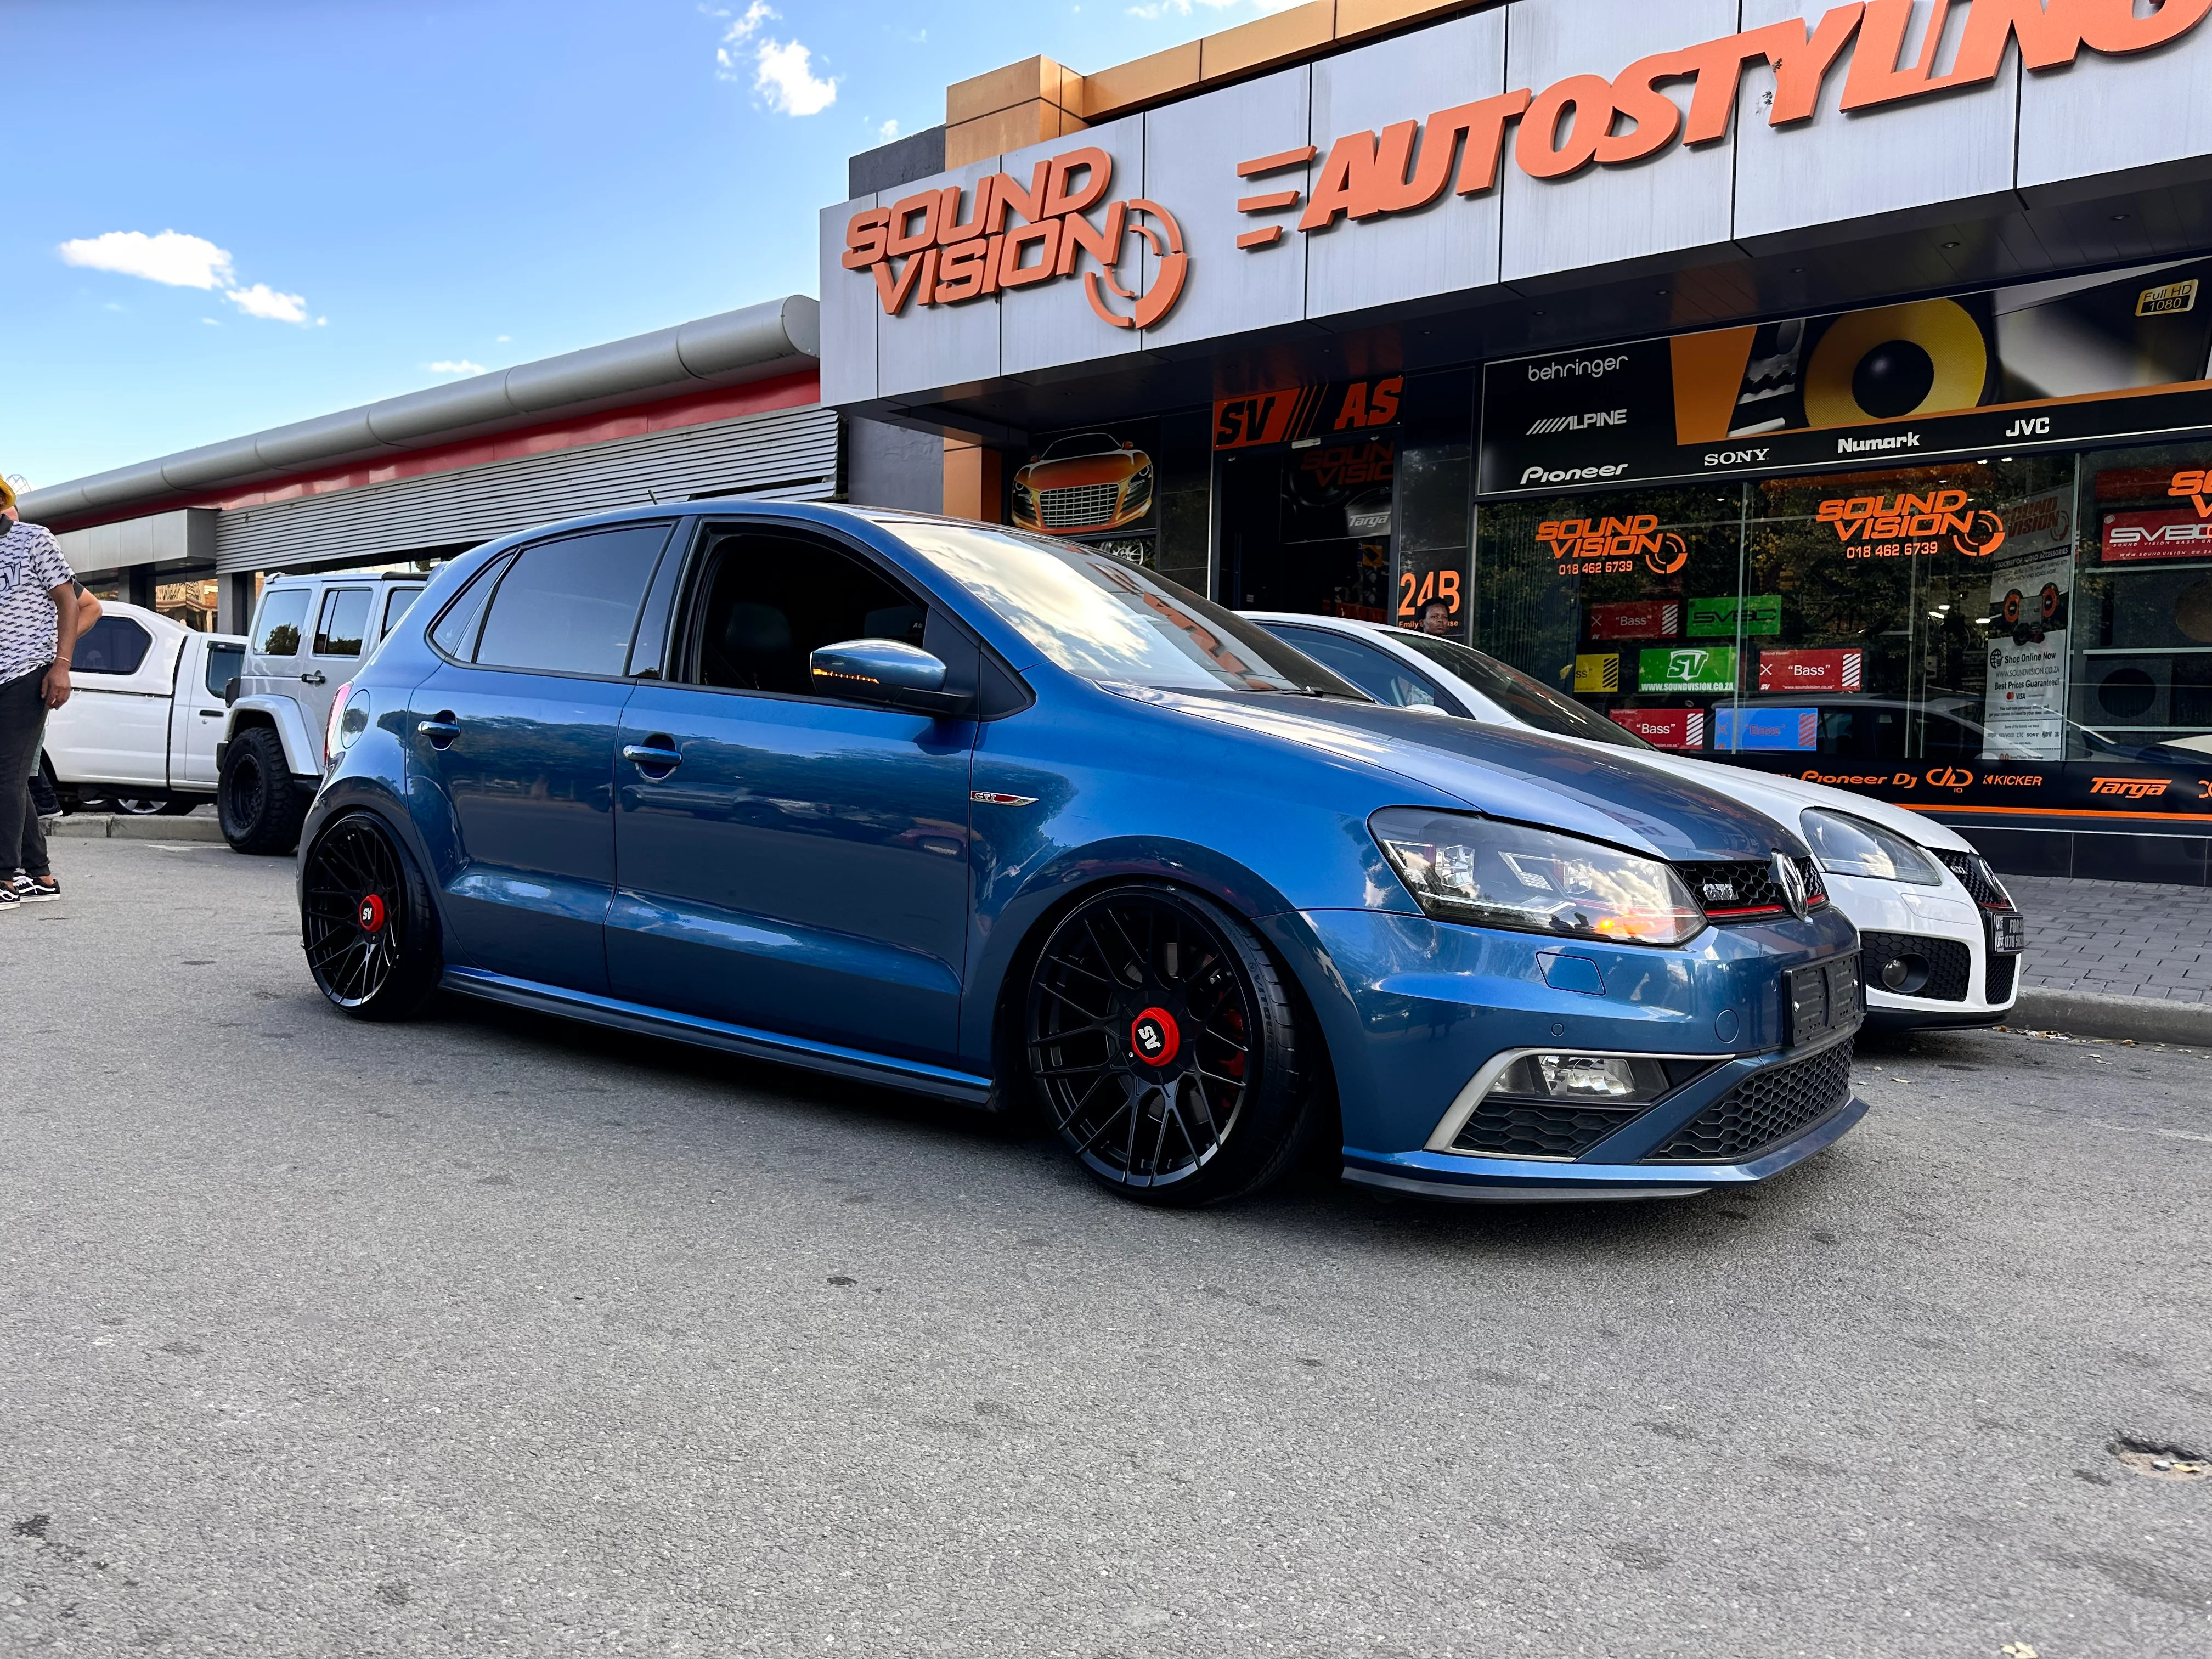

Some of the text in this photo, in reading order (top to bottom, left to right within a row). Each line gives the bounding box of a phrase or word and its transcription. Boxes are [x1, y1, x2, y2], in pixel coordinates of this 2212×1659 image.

[842, 146, 1112, 269] SOUND
[871, 201, 1128, 315] VISION
[2143, 284, 2192, 302] Full HD
[2149, 298, 2182, 312] 1080
[1528, 355, 1628, 381] behringer
[1334, 377, 1404, 430] AS
[1216, 396, 1277, 445] SV
[1536, 409, 1627, 434] ALPINE
[2006, 417, 2050, 437] JVC
[1838, 432, 1920, 453] Numark
[1300, 439, 1395, 471] SOUN
[1704, 448, 1769, 466] SONY
[1520, 463, 1629, 484] Pioneer
[1816, 489, 1967, 522] SOUND
[1349, 511, 1391, 528] Targa
[1536, 515, 1658, 541] SOUND
[1833, 510, 1974, 541] VISION
[2008, 510, 2060, 538] VISION
[1550, 533, 1663, 558] VISION
[1847, 541, 1938, 558] 018 462 6739
[2039, 547, 2068, 560] ACCESSORIES
[1559, 560, 1633, 575] 018 462 6739
[1398, 570, 1460, 616] 24B
[1667, 652, 1708, 679] SV
[2005, 651, 2057, 664] Shop Online Now
[1641, 682, 1734, 691] WWW.SOUNDVISION.CO.ZA
[1995, 681, 2007, 690] Best
[2008, 681, 2024, 689] Prices
[1801, 770, 1888, 785] Pioneer
[1994, 775, 2042, 786] KICKER
[2090, 777, 2172, 799] Targa
[974, 792, 996, 802] GTI
